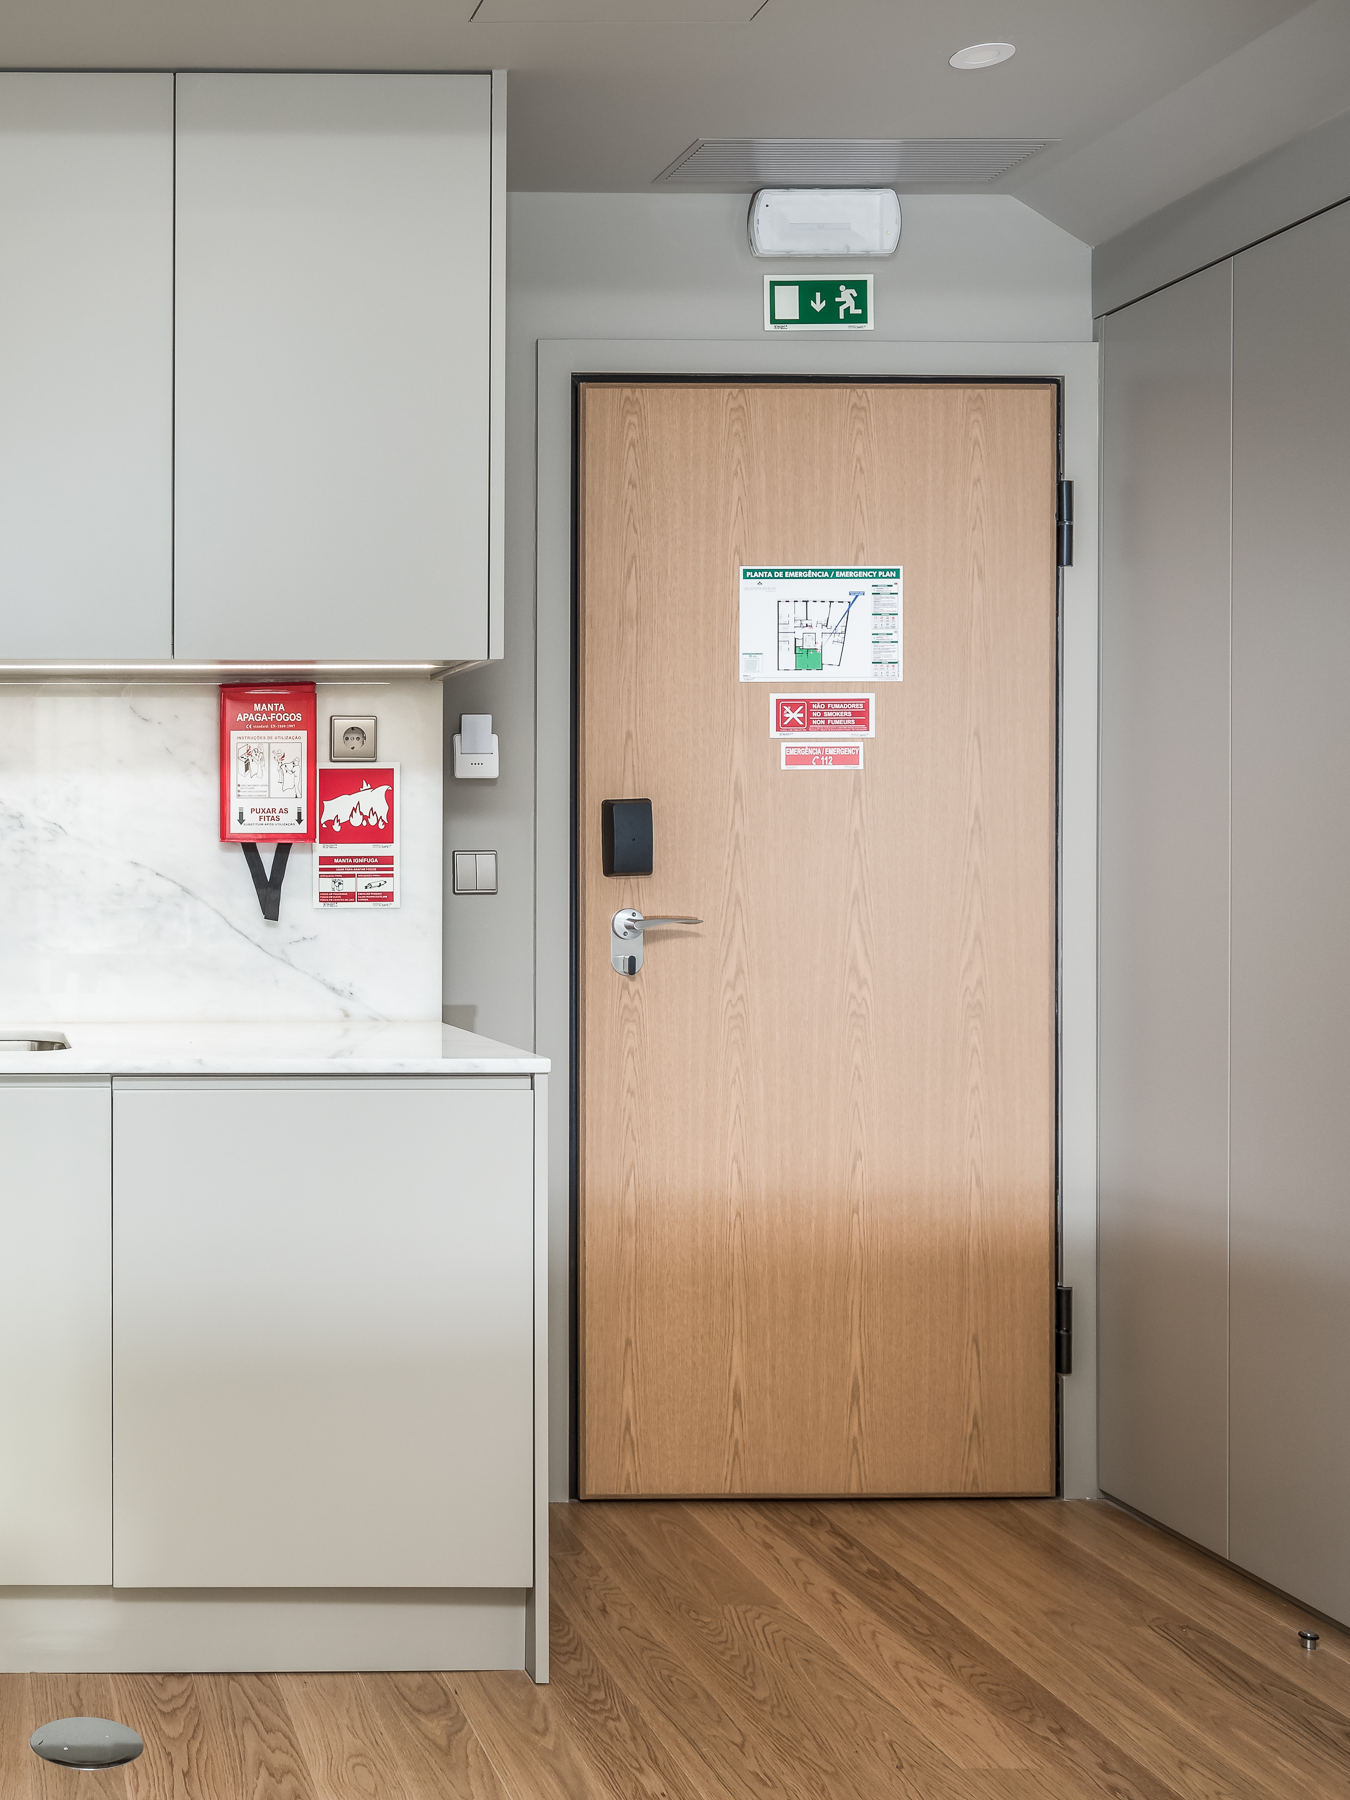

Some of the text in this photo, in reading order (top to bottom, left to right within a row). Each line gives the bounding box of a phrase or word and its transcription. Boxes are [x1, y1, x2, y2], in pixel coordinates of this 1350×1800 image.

[785, 570, 829, 578] EMERGÊNCIA
[253, 703, 285, 711] MANTA
[236, 712, 302, 722] APAGA-FOGOS
[785, 746, 821, 755] EMERGÊNCIA
[825, 747, 860, 755] EMERGENCY
[820, 756, 833, 765] 112
